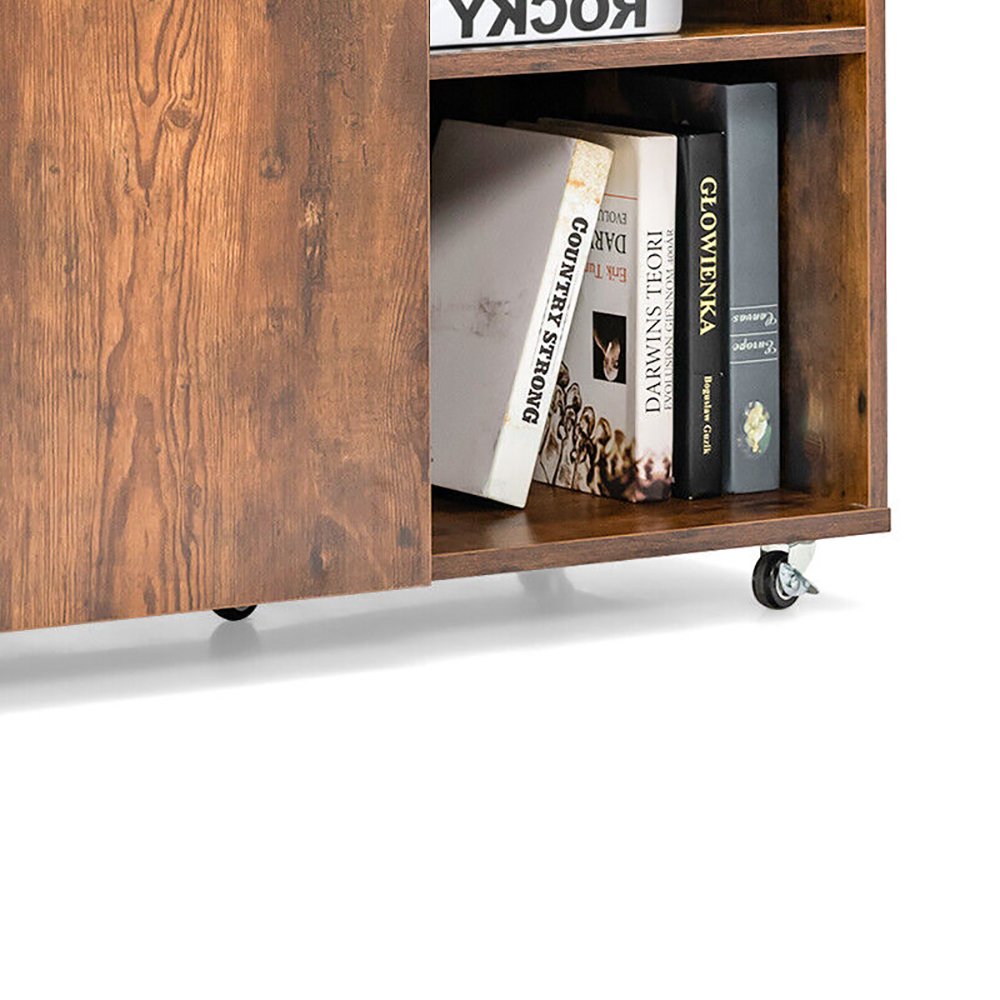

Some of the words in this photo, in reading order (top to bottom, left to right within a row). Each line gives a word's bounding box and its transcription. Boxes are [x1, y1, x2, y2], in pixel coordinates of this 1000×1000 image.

[547, 216, 589, 328] COUNTRY
[591, 230, 628, 254] DAR
[606, 264, 627, 283] Erik
[645, 230, 663, 300] TEORI
[699, 176, 718, 337] GŁOWIENKA
[521, 329, 558, 425] STRONG
[644, 305, 663, 414] DARWINS
